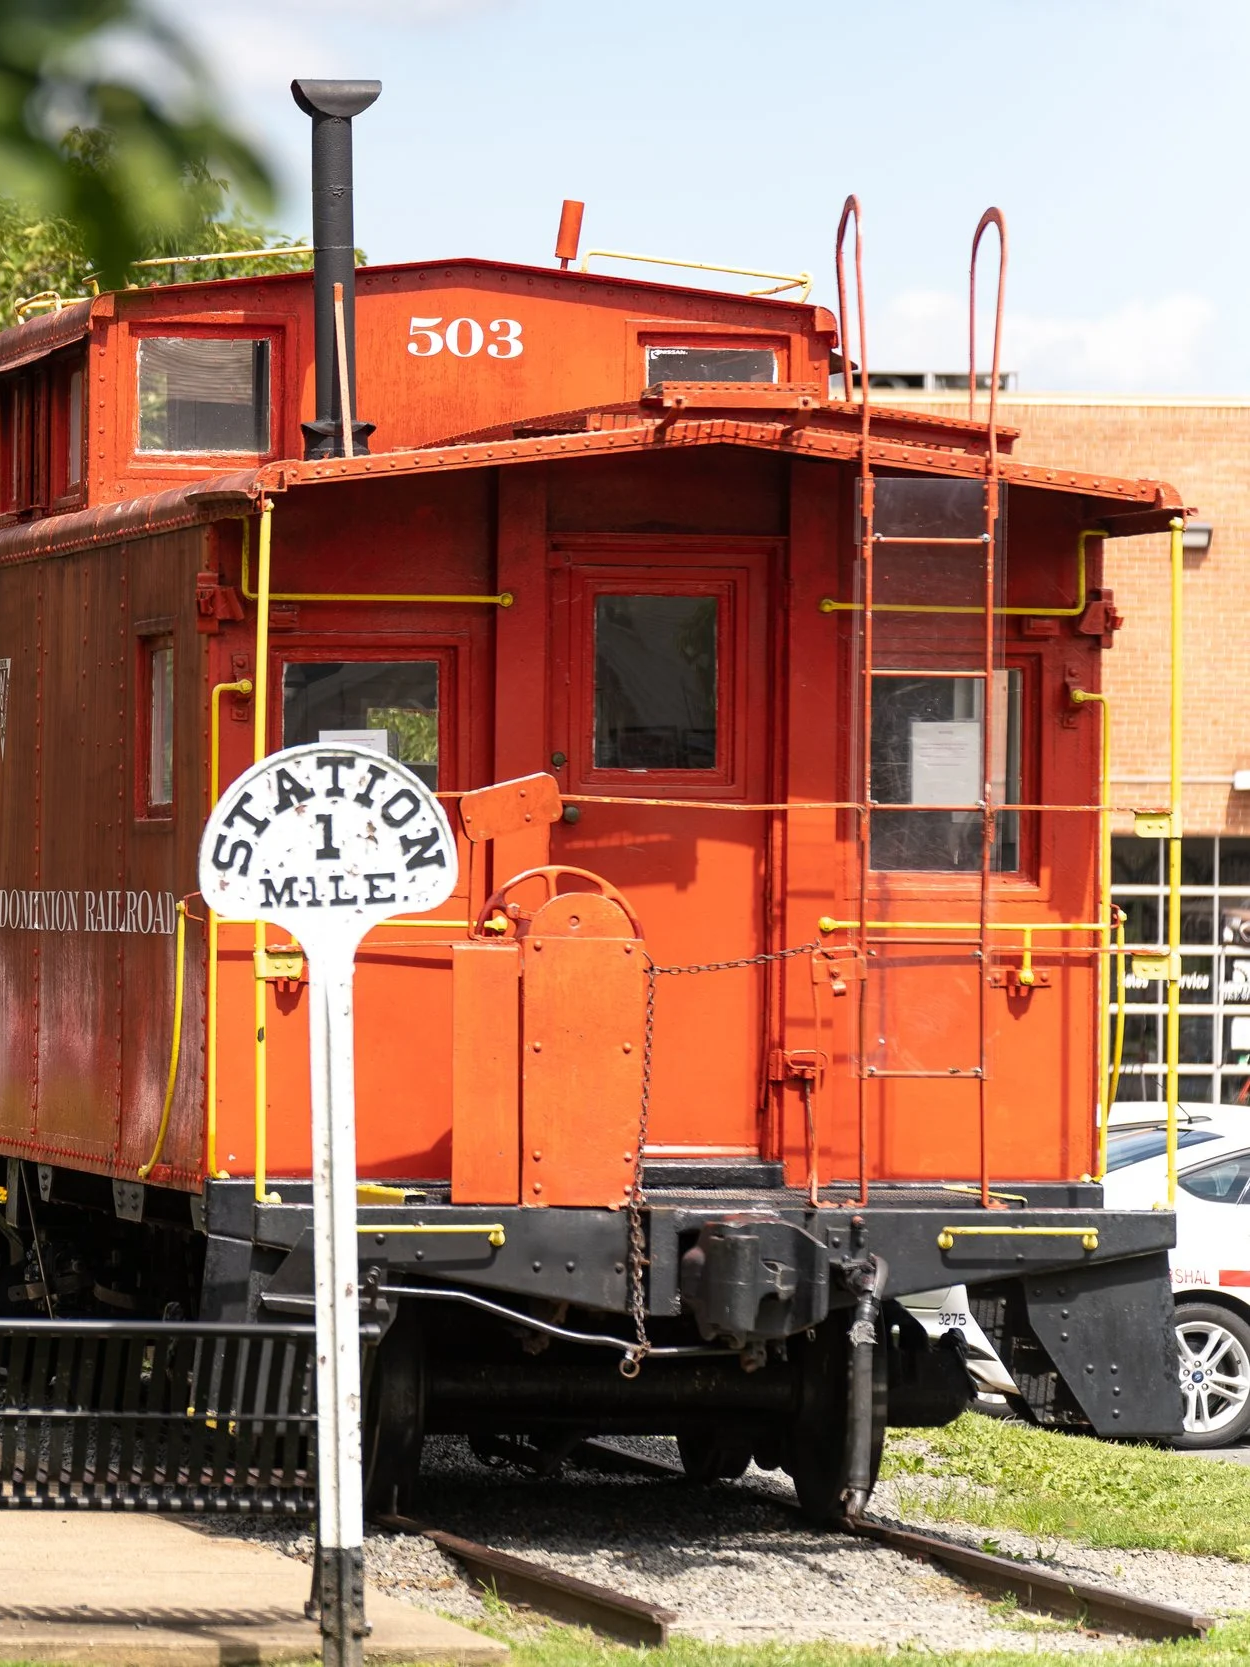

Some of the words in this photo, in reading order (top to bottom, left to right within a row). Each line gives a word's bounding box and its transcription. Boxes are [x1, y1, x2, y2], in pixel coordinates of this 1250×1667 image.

[407, 316, 524, 359] 503
[211, 756, 447, 877] STATION
[314, 813, 341, 860] 1
[84, 890, 176, 935] RAILROAD
[938, 1312, 967, 1326] 3275
